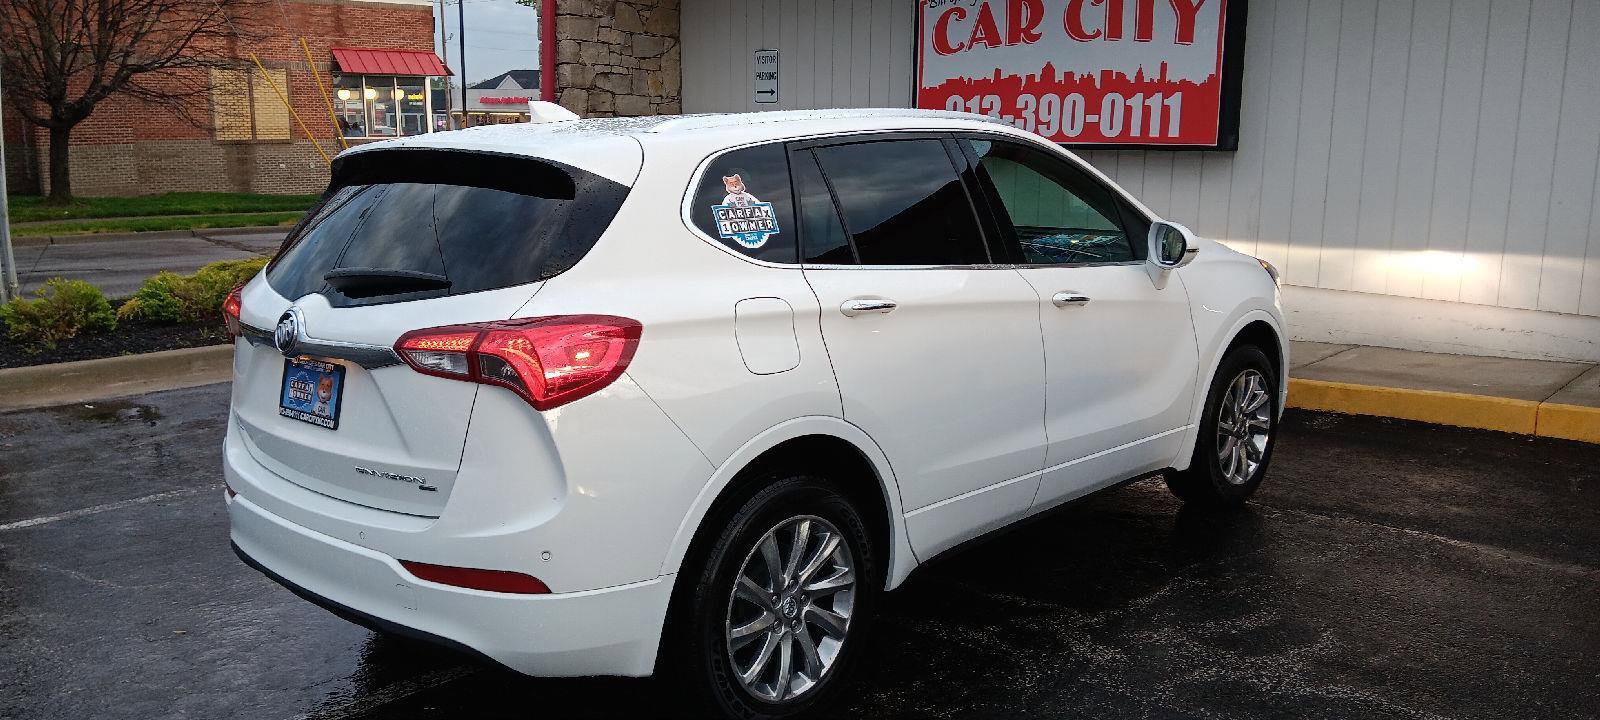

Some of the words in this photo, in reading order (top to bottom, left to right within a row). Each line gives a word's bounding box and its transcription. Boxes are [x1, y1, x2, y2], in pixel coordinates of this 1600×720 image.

[932, 0, 1045, 56] CAR
[1063, 0, 1208, 46] CITY
[757, 55, 777, 65] VISITOR
[756, 71, 777, 81] PARKING
[718, 207, 772, 221] CARFAX
[731, 219, 775, 232] OWNER
